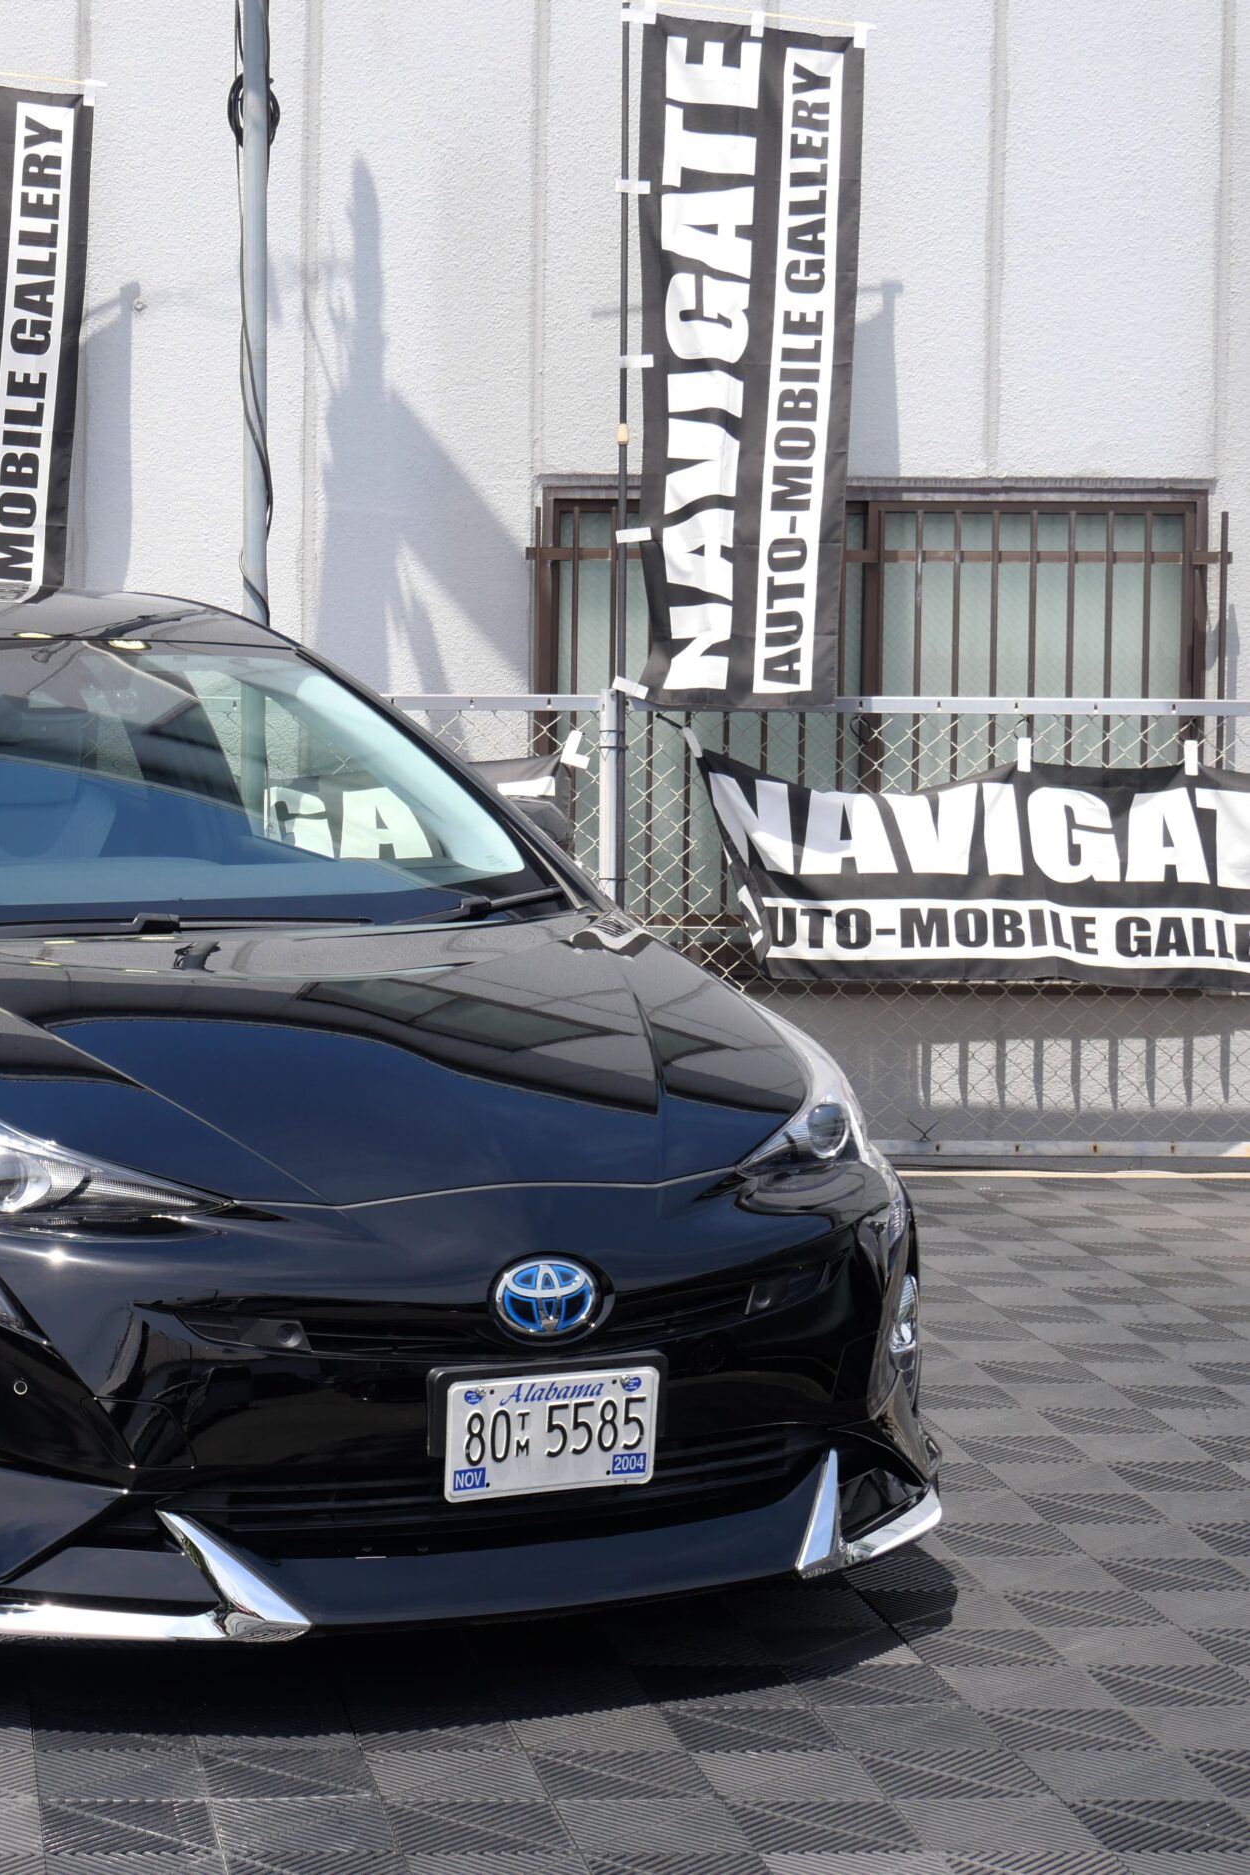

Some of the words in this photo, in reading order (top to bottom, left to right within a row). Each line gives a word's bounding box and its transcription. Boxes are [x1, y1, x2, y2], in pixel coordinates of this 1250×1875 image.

[786, 63, 831, 294] GALLERY
[9, 115, 63, 356] GALLERY
[661, 36, 763, 690] NAVIGATE
[762, 309, 824, 686] AUTO-MOBILE
[750, 906, 1096, 956] UTO-MOBILE
[499, 1382, 604, 1407] Alabama
[545, 1396, 647, 1458] 5585
[454, 1470, 483, 1489] NOV
[613, 1455, 645, 1472] 2004
